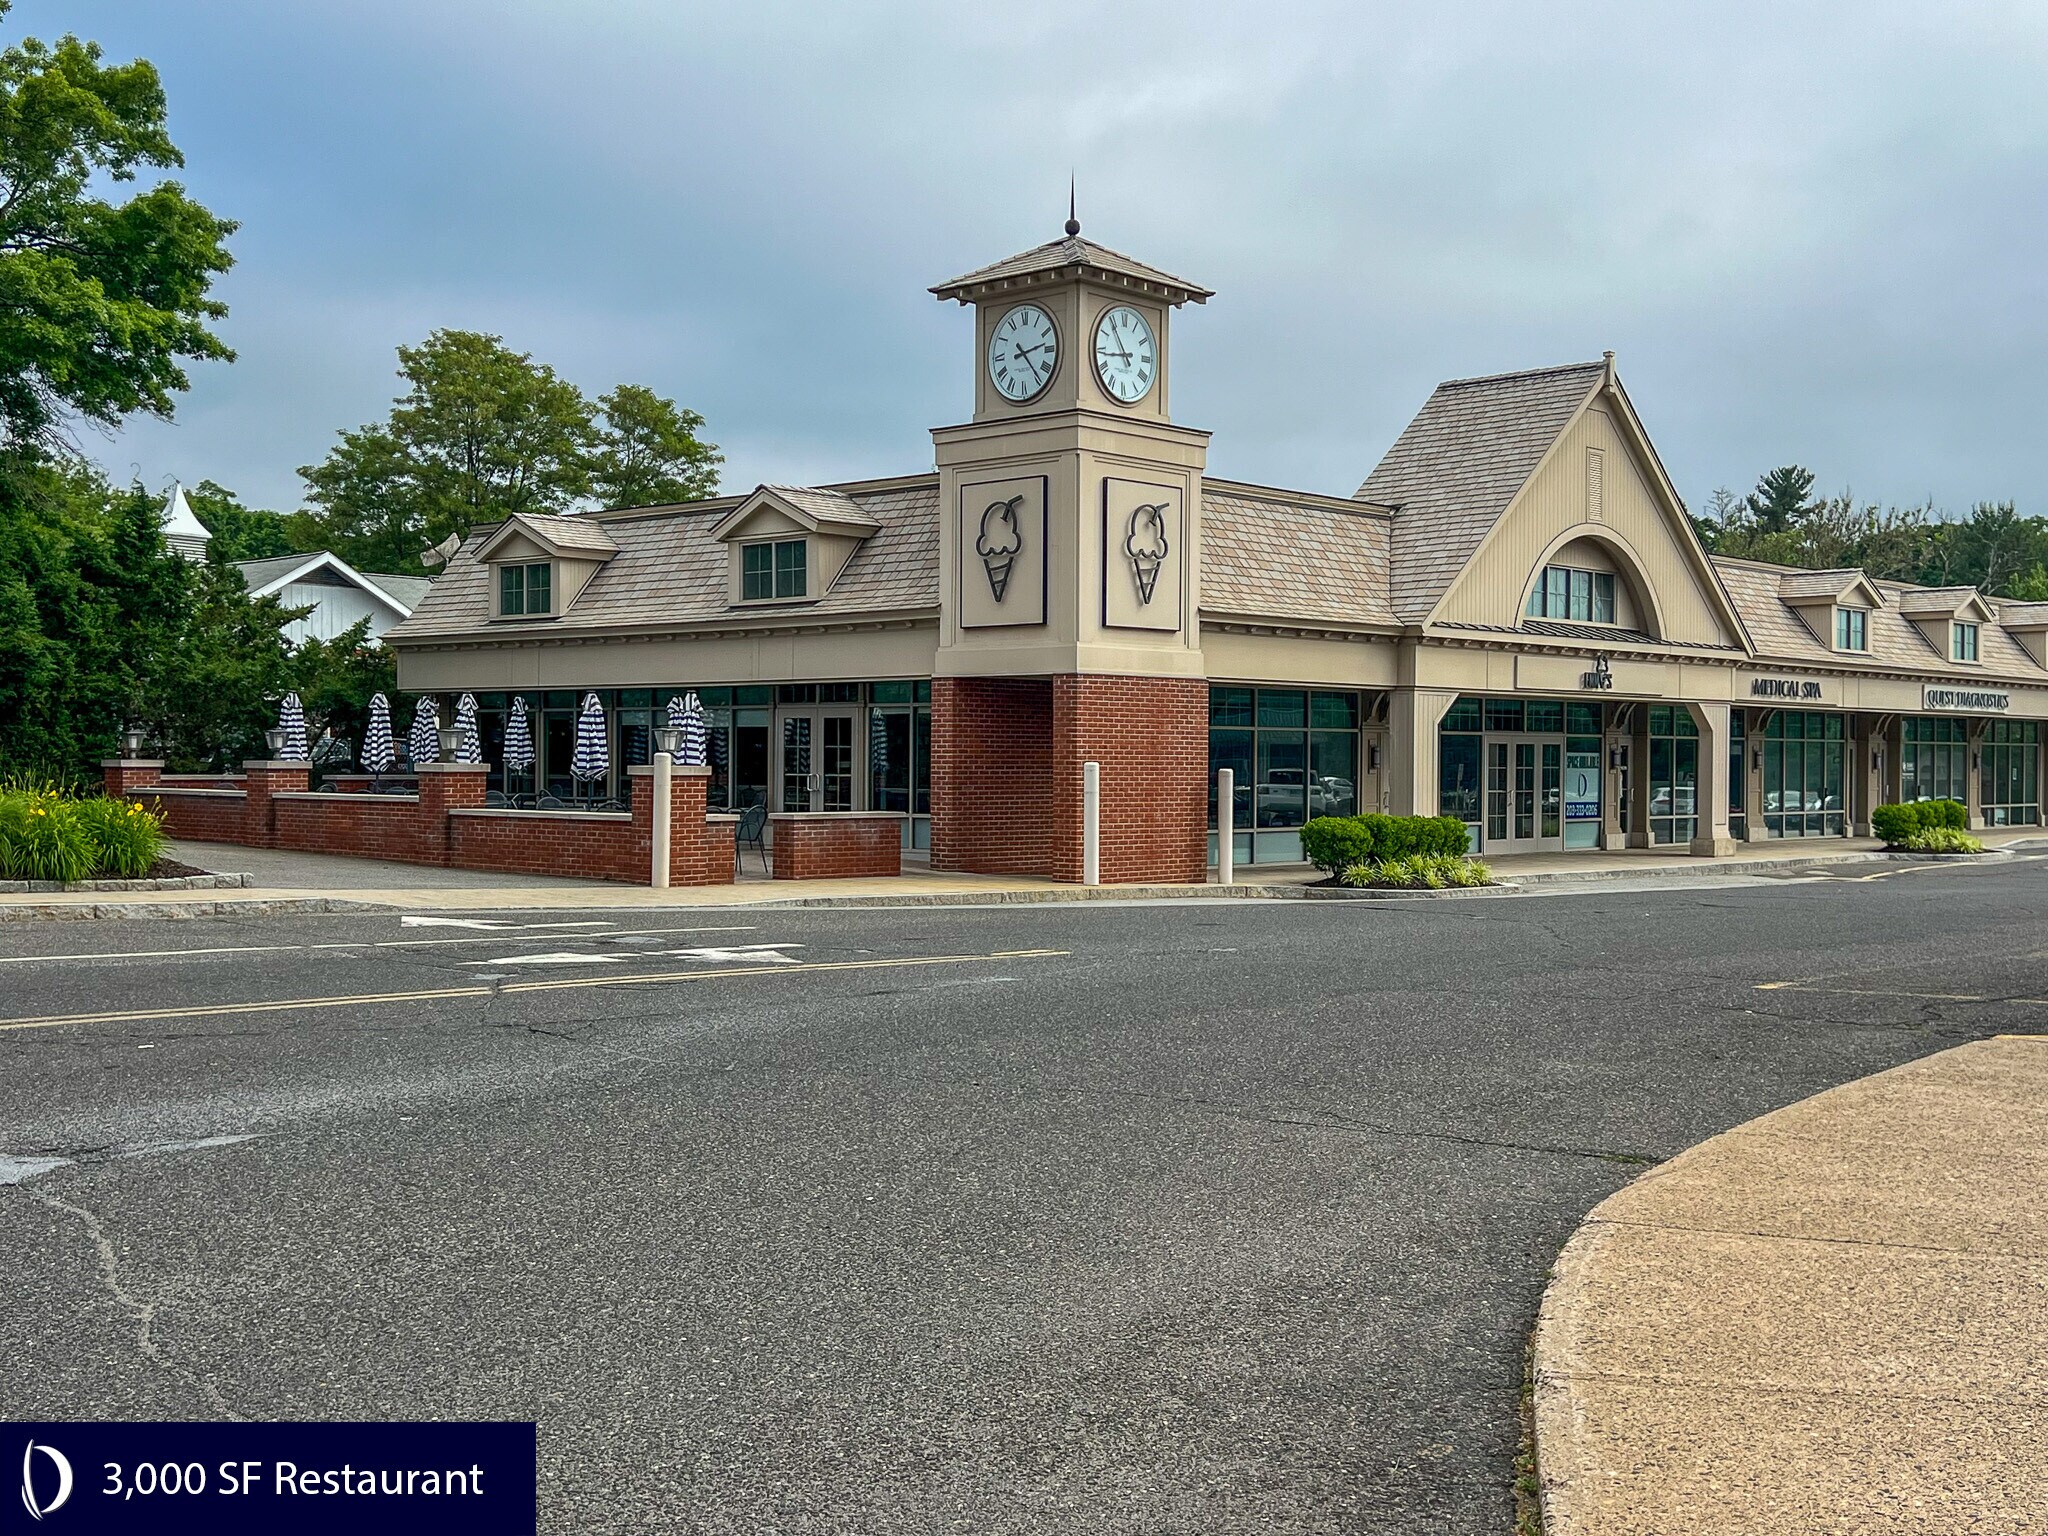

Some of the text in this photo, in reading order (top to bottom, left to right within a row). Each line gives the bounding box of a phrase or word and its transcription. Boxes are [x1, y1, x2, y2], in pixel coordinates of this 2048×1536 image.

[1753, 678, 1822, 698] MEDICAL SPA
[1956, 692, 2009, 708] DIAGNOSTICS
